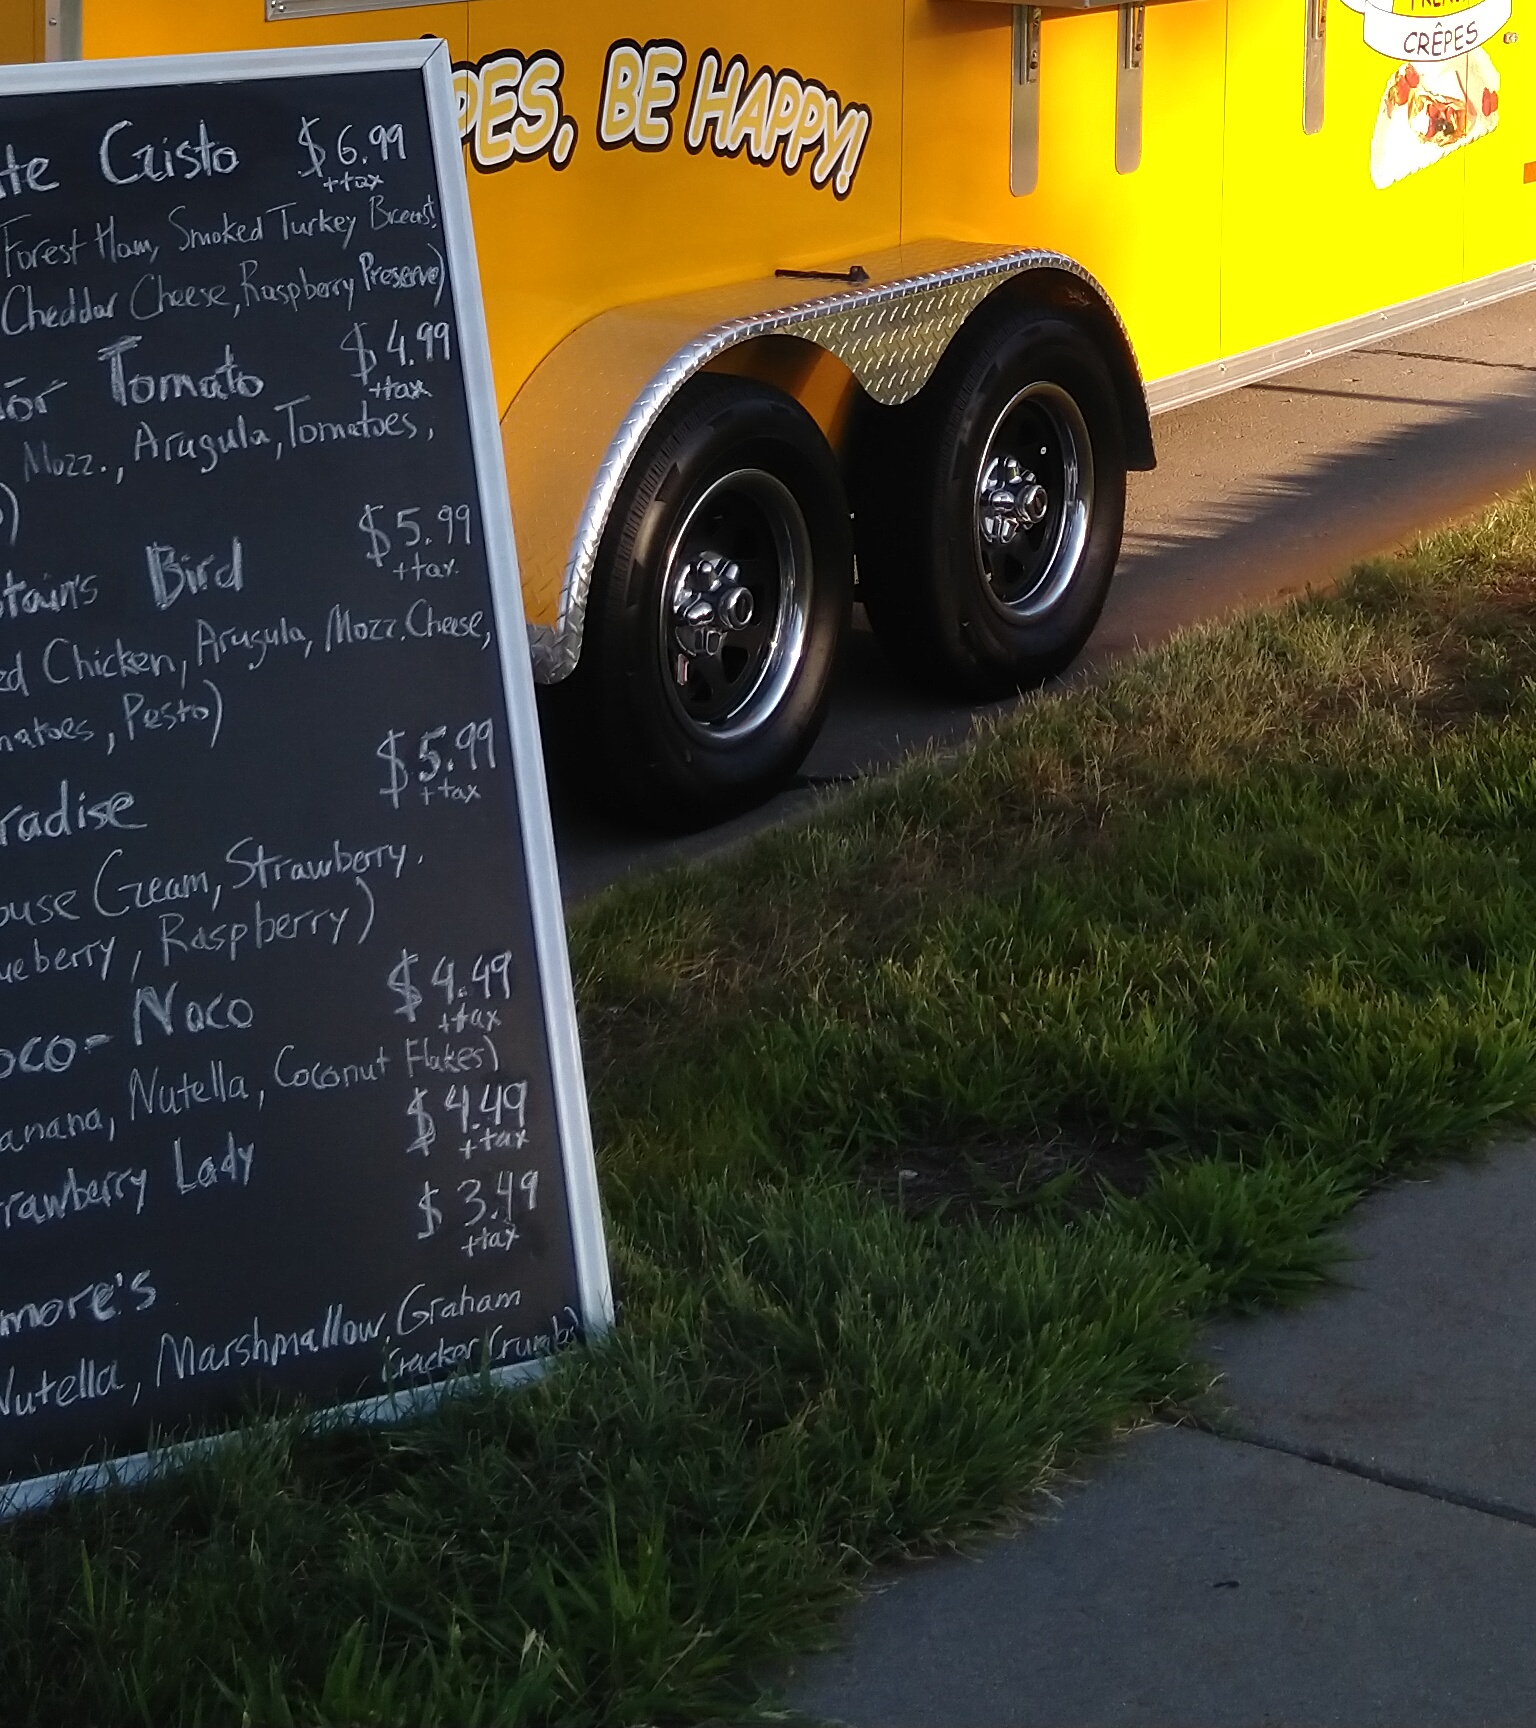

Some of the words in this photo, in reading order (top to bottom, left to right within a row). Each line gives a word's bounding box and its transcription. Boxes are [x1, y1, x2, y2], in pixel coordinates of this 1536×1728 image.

[1404, 21, 1479, 56] CRÊPES
[450, 50, 578, 172] PES,
[596, 39, 687, 151] BE
[685, 47, 872, 201] HAPPY!
[168, 205, 264, 251] Smoked
[266, 202, 358, 250] Turkey
[239, 259, 355, 312] Raspberry
[97, 335, 264, 406] Tomato
[146, 536, 244, 610] Bird
[132, 981, 254, 1046] Naco
[274, 1044, 390, 1090] Coconut
[174, 1131, 255, 1195] Lady
[396, 1283, 521, 1336] Graham
